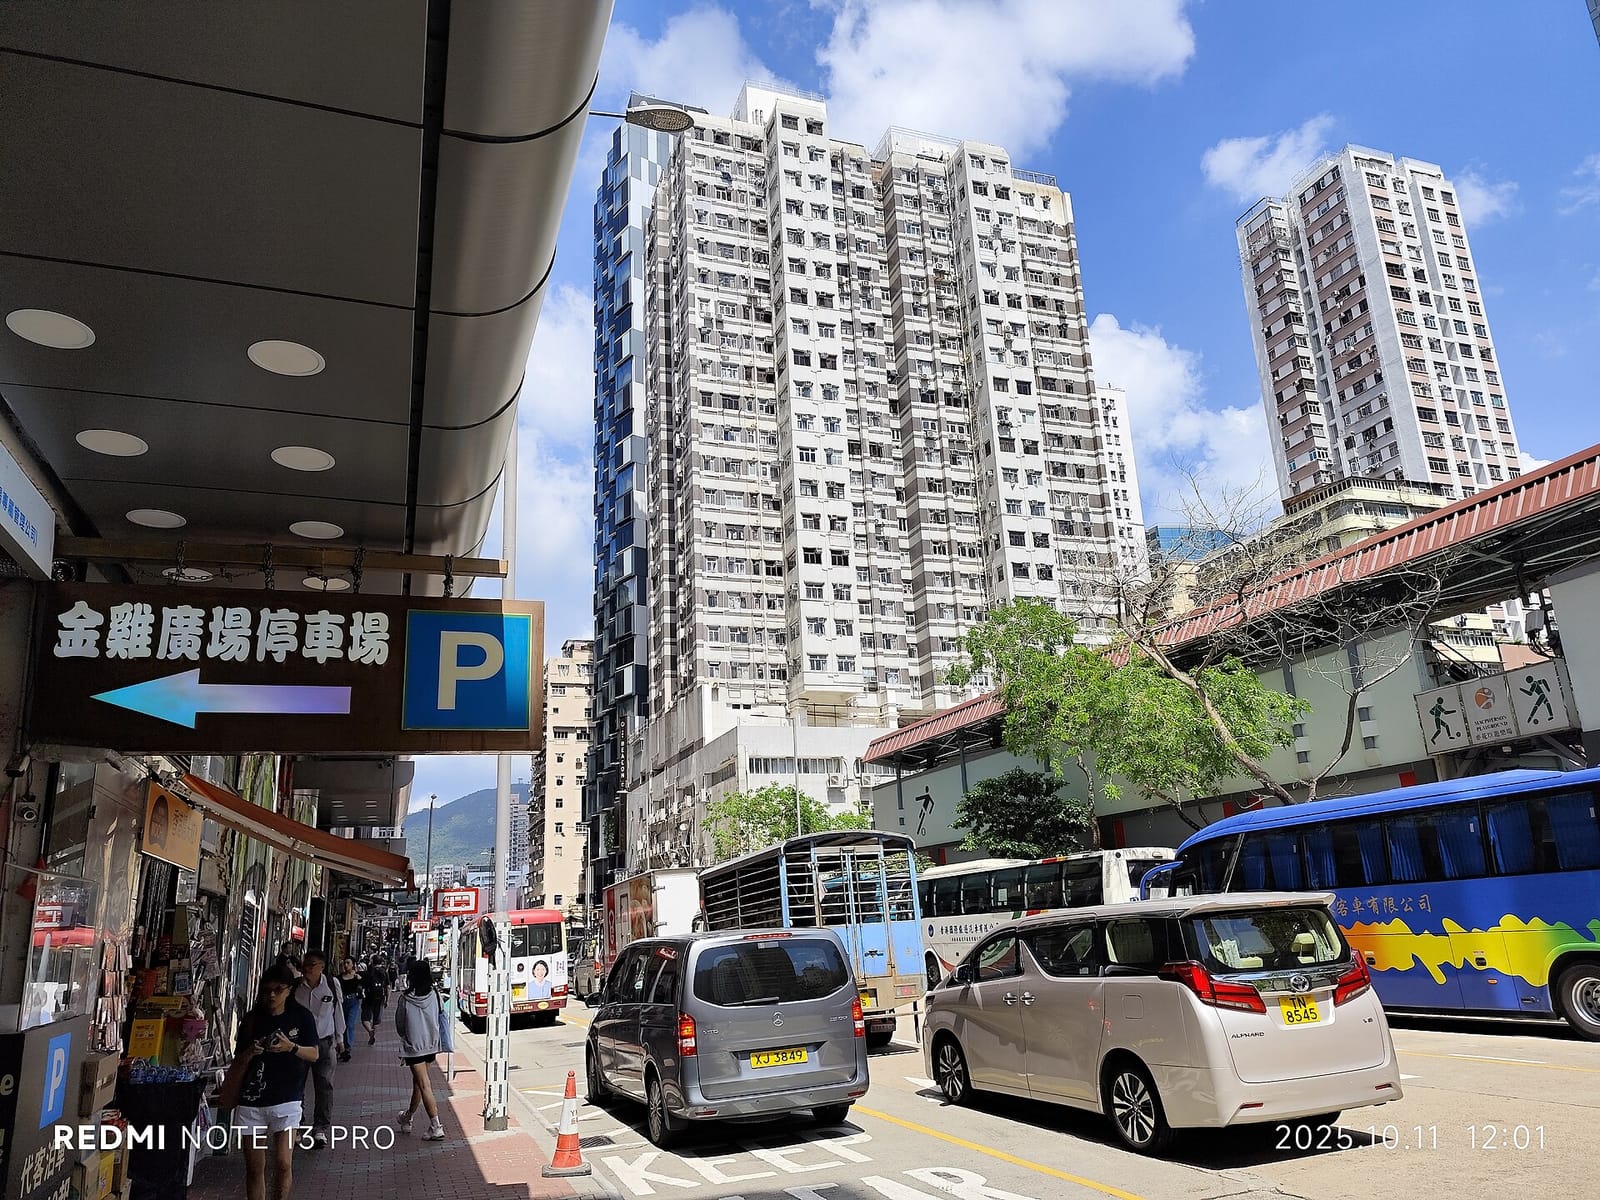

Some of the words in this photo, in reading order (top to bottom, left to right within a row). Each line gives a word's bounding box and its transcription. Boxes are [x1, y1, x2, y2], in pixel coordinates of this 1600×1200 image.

[53, 600, 390, 665] 金雞廣場停車場
[437, 631, 505, 710] P
[1332, 894, 1432, 917] 客車有限公司
[1290, 996, 1307, 1009] TN
[1286, 1007, 1318, 1023] 8545
[1231, 1031, 1265, 1039] ALPHARD
[755, 1053, 770, 1065] XJ
[775, 1050, 803, 1062] 3849
[47, 1047, 65, 1112] P
[601, 1131, 873, 1195] KEEP
